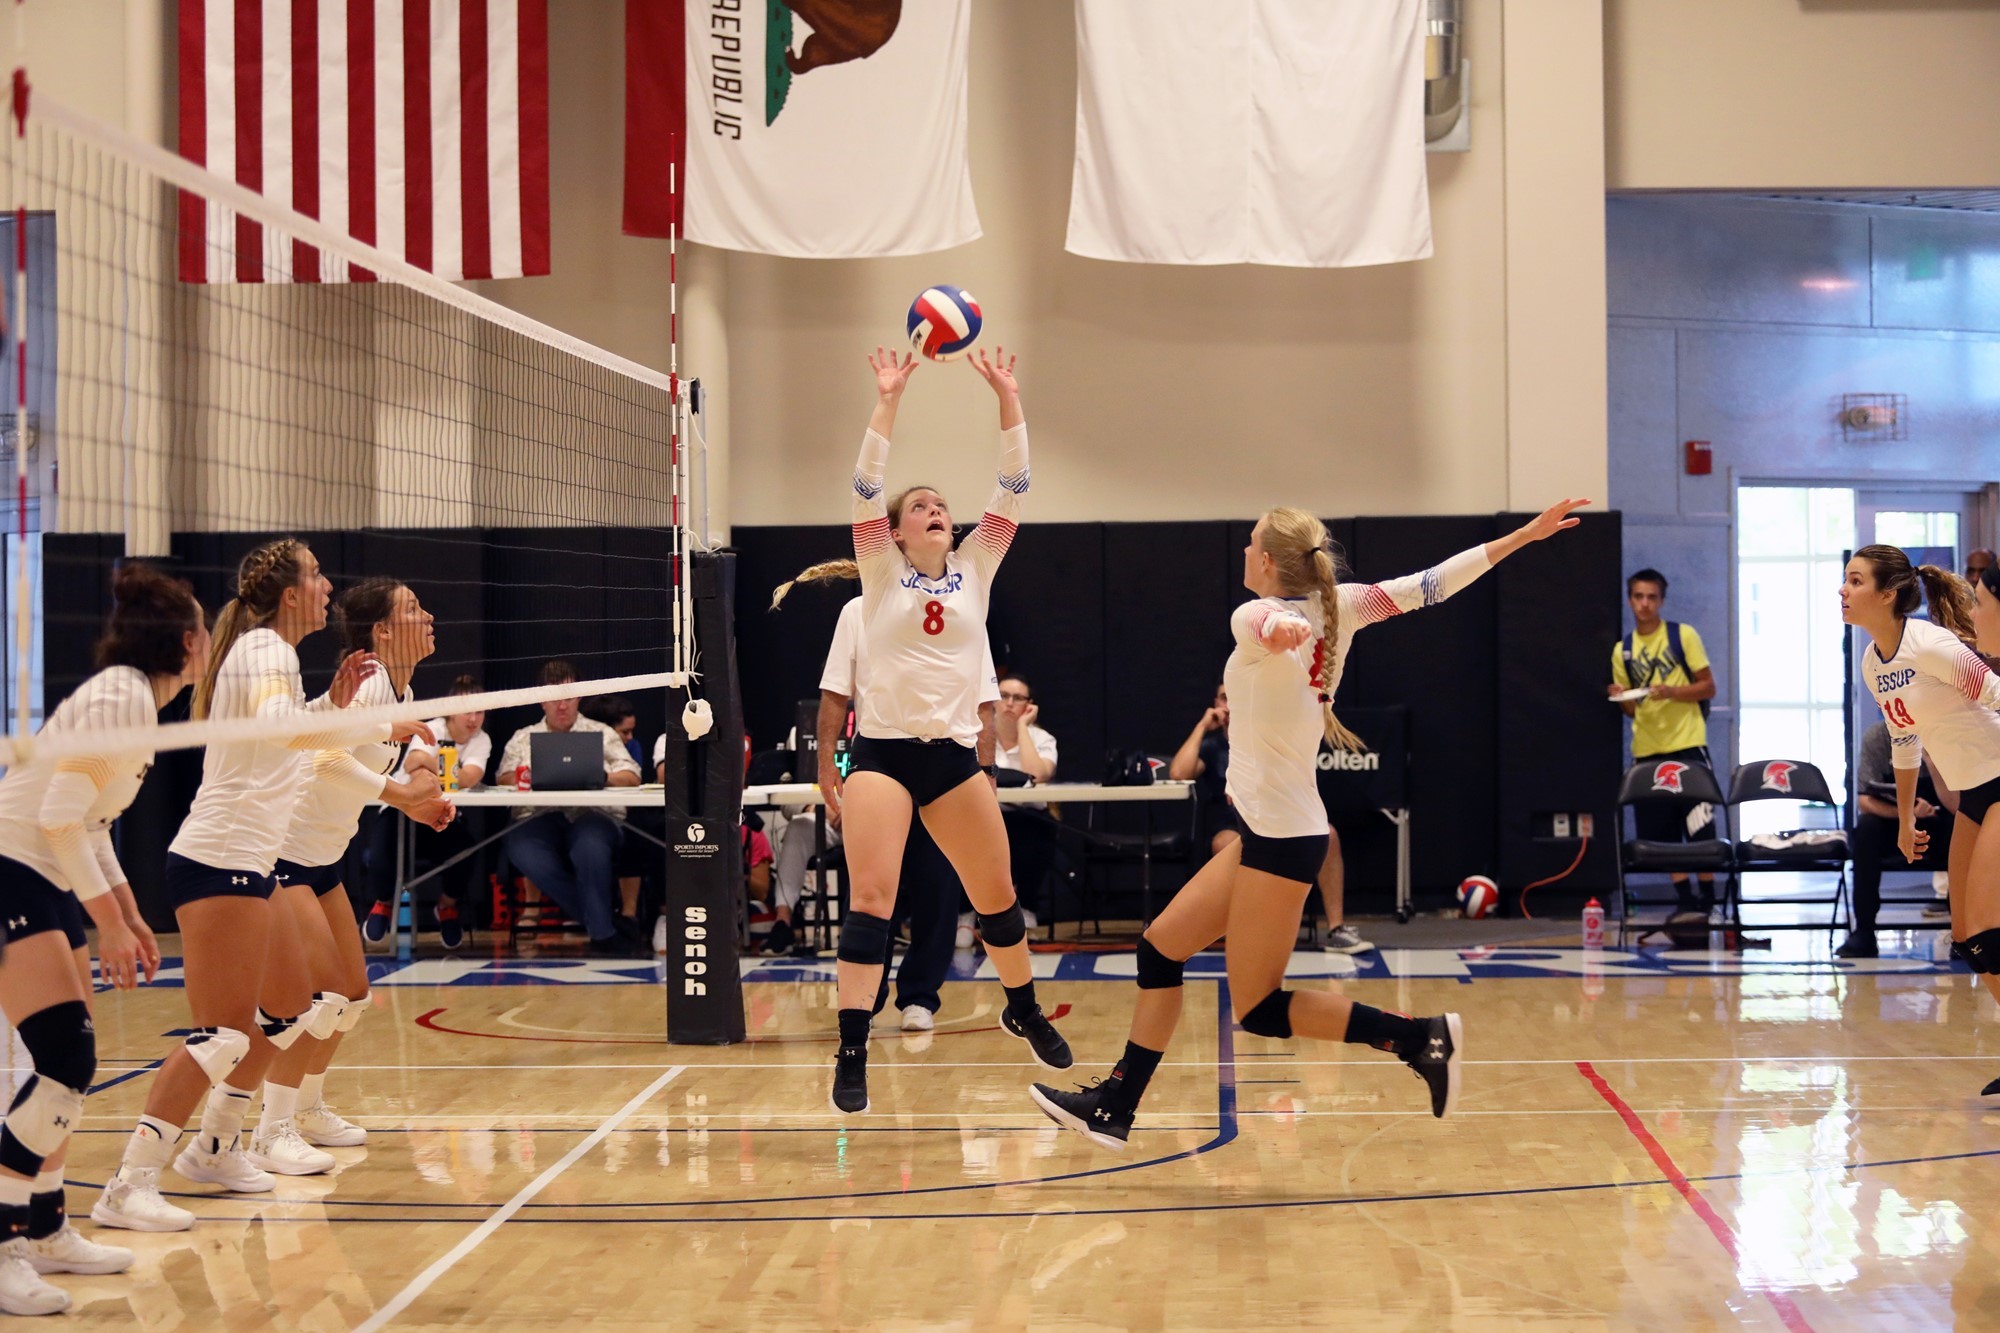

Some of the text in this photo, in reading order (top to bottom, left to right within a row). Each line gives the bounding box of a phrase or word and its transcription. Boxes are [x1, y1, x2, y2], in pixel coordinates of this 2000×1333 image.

[711, 0, 743, 140] REPUBLIC
[923, 600, 945, 636] 8
[1874, 668, 1916, 693] ESSUP
[1884, 697, 1915, 728] 19
[807, 740, 846, 751] HE
[1316, 750, 1380, 771] olten
[684, 906, 708, 996] senoh
